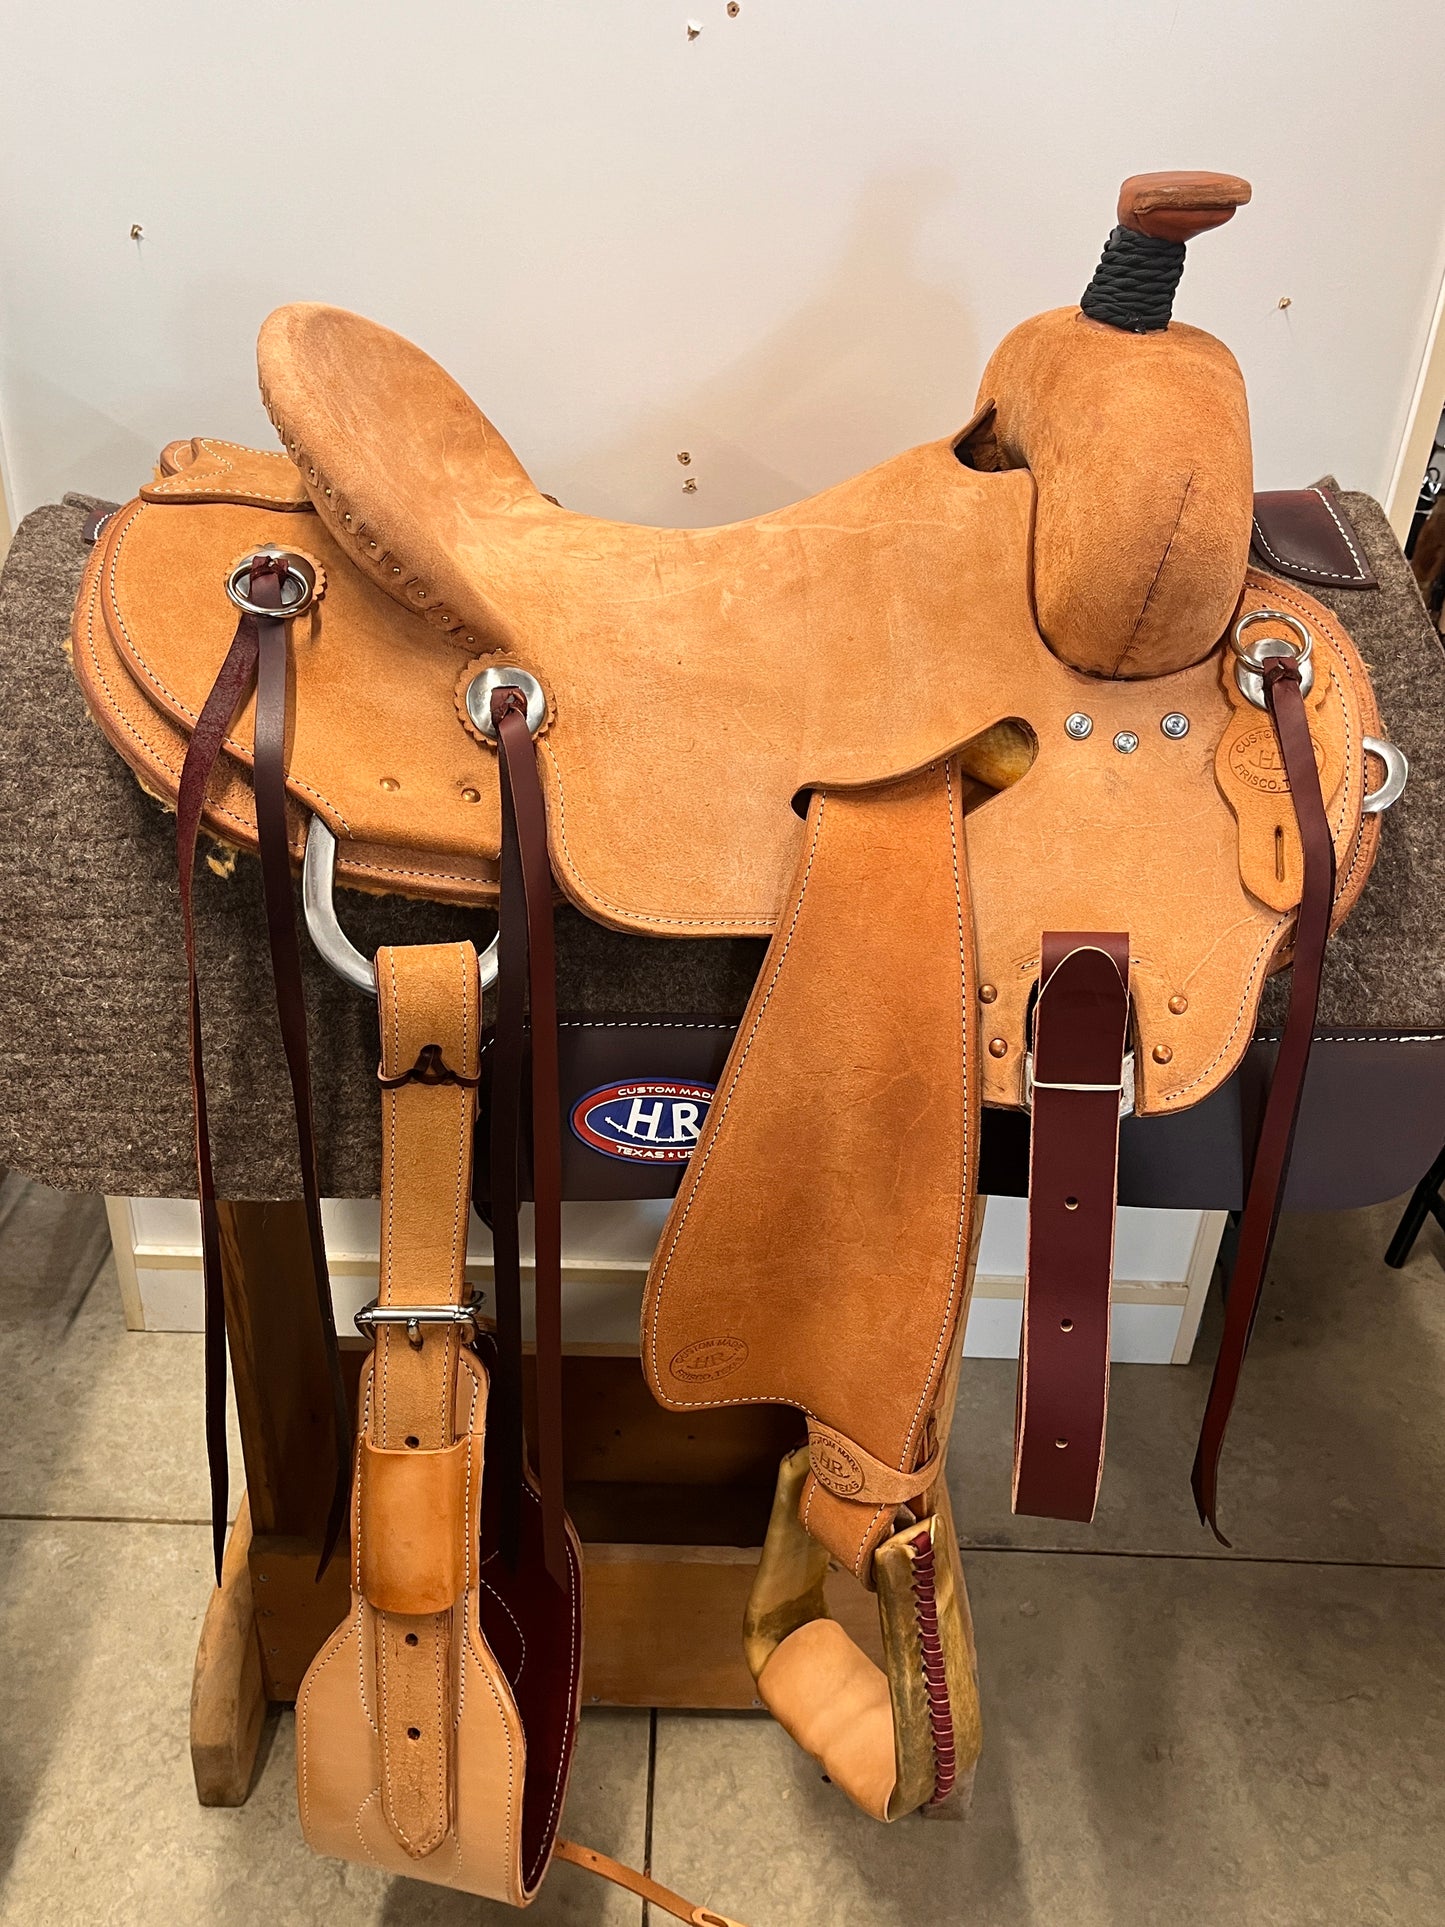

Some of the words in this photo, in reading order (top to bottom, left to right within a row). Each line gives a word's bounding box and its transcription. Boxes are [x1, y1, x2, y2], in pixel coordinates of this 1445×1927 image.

[1235, 729, 1276, 754] CUSTO
[617, 1086, 676, 1096] CUSTOM
[679, 1087, 715, 1100] MAD
[626, 1098, 702, 1142] HR
[616, 1145, 665, 1159] TEXAS
[677, 1150, 694, 1159] US
[675, 1340, 715, 1364] CUSTOM
